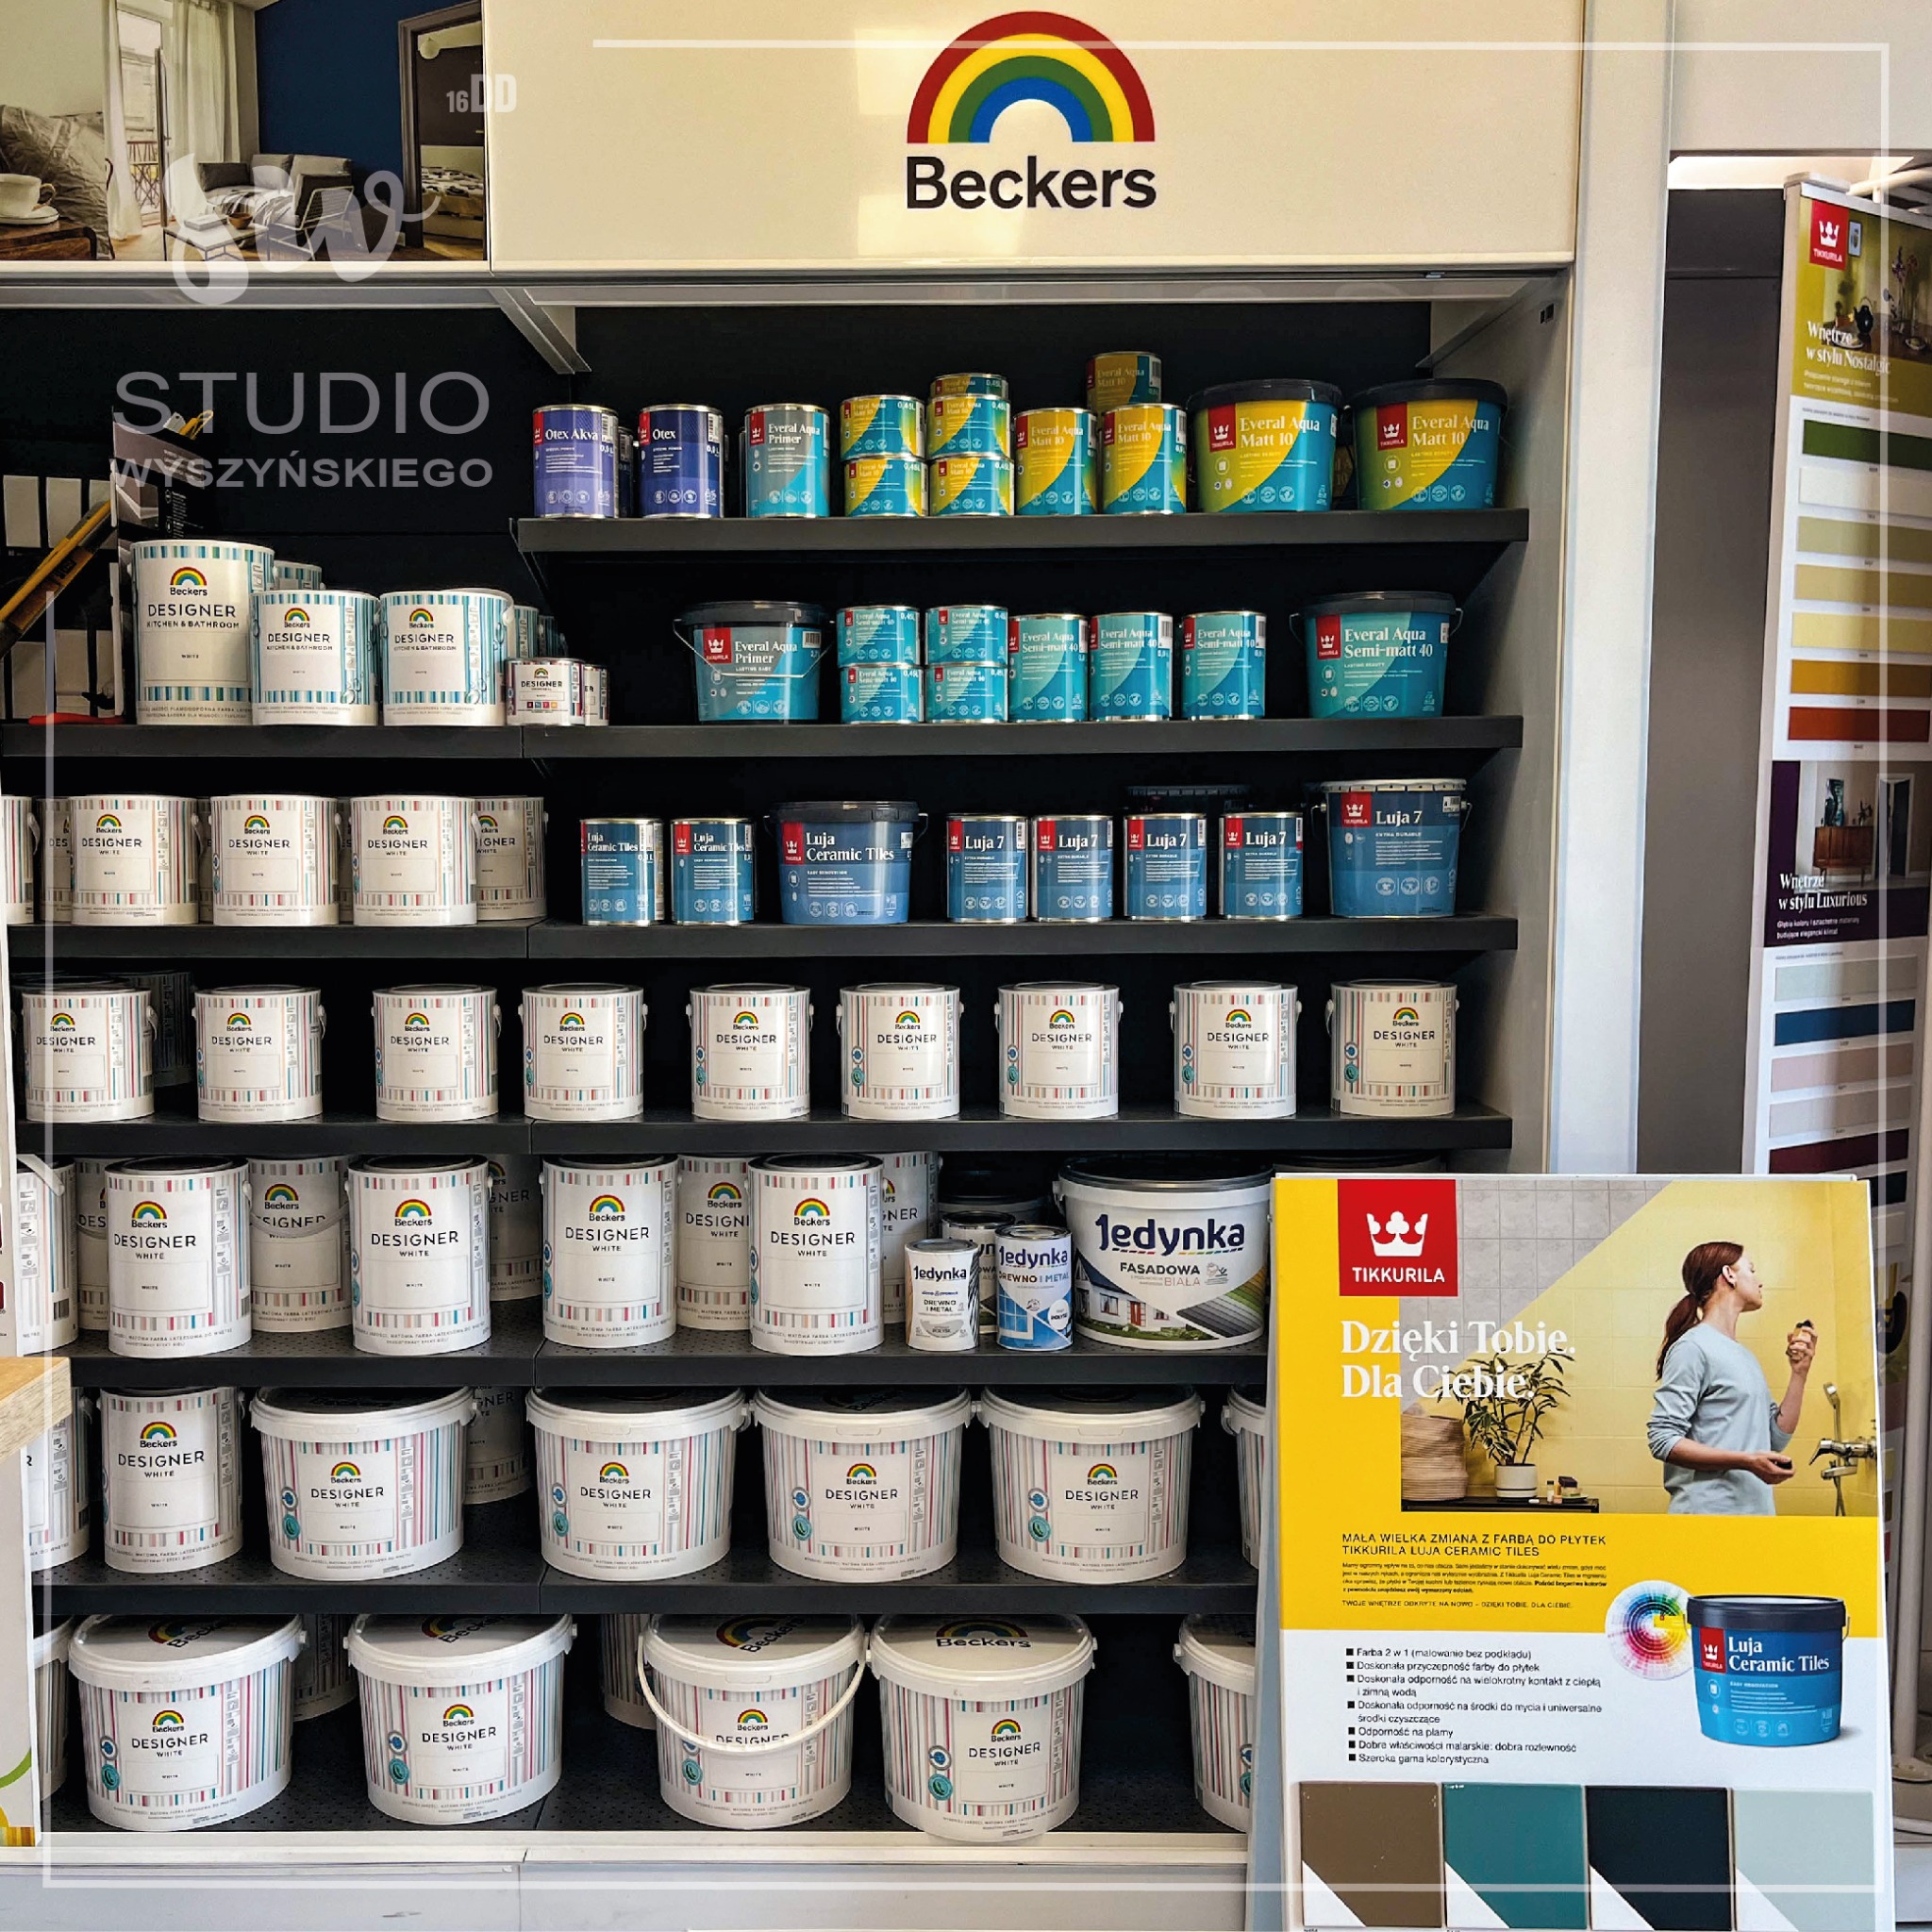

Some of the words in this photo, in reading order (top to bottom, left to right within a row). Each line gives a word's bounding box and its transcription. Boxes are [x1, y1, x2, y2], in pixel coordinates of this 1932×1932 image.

[907, 156, 1157, 208] Beckers
[1806, 348, 1815, 359] w
[1817, 347, 1842, 368] stylu
[768, 422, 796, 434] Everal
[799, 423, 820, 437] Aqua
[1031, 425, 1058, 436] Everal
[1240, 415, 1285, 430] Everal
[1289, 416, 1320, 435] Aqua
[1412, 415, 1457, 430] Everal
[1461, 416, 1489, 434] Aqua
[545, 429, 569, 440] Otex
[572, 429, 598, 441] Akva
[653, 429, 675, 440] Otex
[768, 434, 802, 445] Primer
[1031, 437, 1051, 445] Matt
[1055, 436, 1064, 444] 10
[1241, 433, 1274, 447] Matt
[1279, 431, 1292, 445] 10
[1412, 432, 1446, 447] Matt
[1451, 431, 1465, 445] 10
[170, 587, 208, 596] Beckers
[148, 604, 236, 617] DESIGNER
[268, 633, 330, 642] DESIGNER
[394, 633, 454, 643] DESIGNER
[1023, 632, 1050, 641] Everal
[1053, 633, 1074, 644] Aqua
[1344, 627, 1389, 641] Everal
[1391, 627, 1425, 643] Aqua
[735, 641, 769, 653] Everal
[773, 641, 797, 655] Aqua
[1023, 642, 1066, 653] Semi-matt
[1069, 643, 1077, 652] 40
[1344, 644, 1416, 658] Semi-matt
[1419, 644, 1433, 657] 40
[735, 653, 774, 664] Primer
[1376, 811, 1409, 826] Luja
[1414, 811, 1422, 823] 7
[82, 839, 142, 847] DESIGNER
[368, 840, 427, 848] DESIGNER
[806, 832, 835, 848] Luja
[965, 836, 994, 852] Luja
[997, 836, 1004, 848] 7
[807, 848, 860, 861] Ceramic
[864, 848, 894, 861] Tiles
[1779, 898, 1789, 910] w
[1790, 894, 1814, 913] stylu
[1816, 891, 1868, 909] Luxurious
[543, 1035, 604, 1045] DESIGNER
[716, 1035, 776, 1044] DESIGNER
[1374, 1030, 1435, 1040] DESIGNER
[131, 1219, 167, 1228] Beckers
[589, 1213, 625, 1222] Beckers
[566, 1227, 649, 1241] DESIGNER
[771, 1231, 855, 1246] DESIGNER
[114, 1234, 196, 1248] DESIGNER
[1120, 1262, 1200, 1274] FASADOWA
[1353, 1267, 1444, 1282] TIKKURILA
[1164, 1276, 1201, 1286] BIAŁA
[1341, 1321, 1458, 1361] Dzięki
[1468, 1321, 1575, 1354] Tobie.
[1341, 1365, 1402, 1398] Dla
[1413, 1365, 1534, 1398] Ciebie.
[118, 1450, 205, 1468] DESIGNER
[310, 1486, 384, 1499] DESIGNER
[580, 1487, 651, 1499] DESIGNER
[1065, 1489, 1139, 1502] DESIGNER
[1342, 1534, 1376, 1542] MAŁA
[1380, 1534, 1426, 1543] WIELKA
[1431, 1535, 1476, 1543] ZMIANA
[1482, 1535, 1489, 1543] Z
[1494, 1535, 1534, 1546] FARBĄ
[1539, 1536, 1556, 1544] DO
[1560, 1536, 1606, 1545] PŁYTEK
[1342, 1545, 1406, 1555] TIKKURILA
[1410, 1546, 1440, 1556] LUJA
[1445, 1546, 1501, 1556] CERAMIC
[1507, 1547, 1540, 1556] TILES
[937, 1637, 1031, 1648] Beckers
[1728, 1637, 1762, 1656] Luja
[1405, 1649, 1408, 1657] 1
[1411, 1649, 1463, 1658] (malowanie
[1466, 1650, 1482, 1658] bez
[1485, 1650, 1532, 1659] podkładu)
[1357, 1661, 1405, 1670] Doskonała
[1407, 1662, 1470, 1673] przyczepność
[1473, 1663, 1494, 1673] farby
[1498, 1663, 1509, 1672] do
[1512, 1663, 1540, 1673] płytek
[1729, 1656, 1795, 1673] Ceramic
[1798, 1656, 1829, 1672] Tiles
[1357, 1674, 1405, 1683] Doskonała
[1407, 1675, 1457, 1685] odporność
[1474, 1675, 1526, 1687] wielokrotny
[1573, 1677, 1601, 1688] ciepłą
[1363, 1688, 1389, 1698] zimną
[1392, 1689, 1417, 1698] wodą
[1358, 1701, 1405, 1710] Doskonała
[1407, 1702, 1455, 1711] odporność
[1471, 1702, 1498, 1710] środki
[1501, 1703, 1512, 1711] do
[1515, 1703, 1541, 1713] mycia
[1358, 1714, 1386, 1723] środki
[1389, 1715, 1440, 1724] czyszczące
[421, 1726, 497, 1743] DESIGNER
[1358, 1727, 1409, 1738] Odporność
[1425, 1728, 1453, 1738] plamy
[131, 1732, 208, 1749] DESIGNER
[969, 1742, 1041, 1758] DESIGNER
[1495, 1742, 1523, 1752] dobra
[1359, 1754, 1396, 1762] Szeroka
[1399, 1756, 1424, 1765] gama
[1426, 1755, 1489, 1765] kolorystyczna
